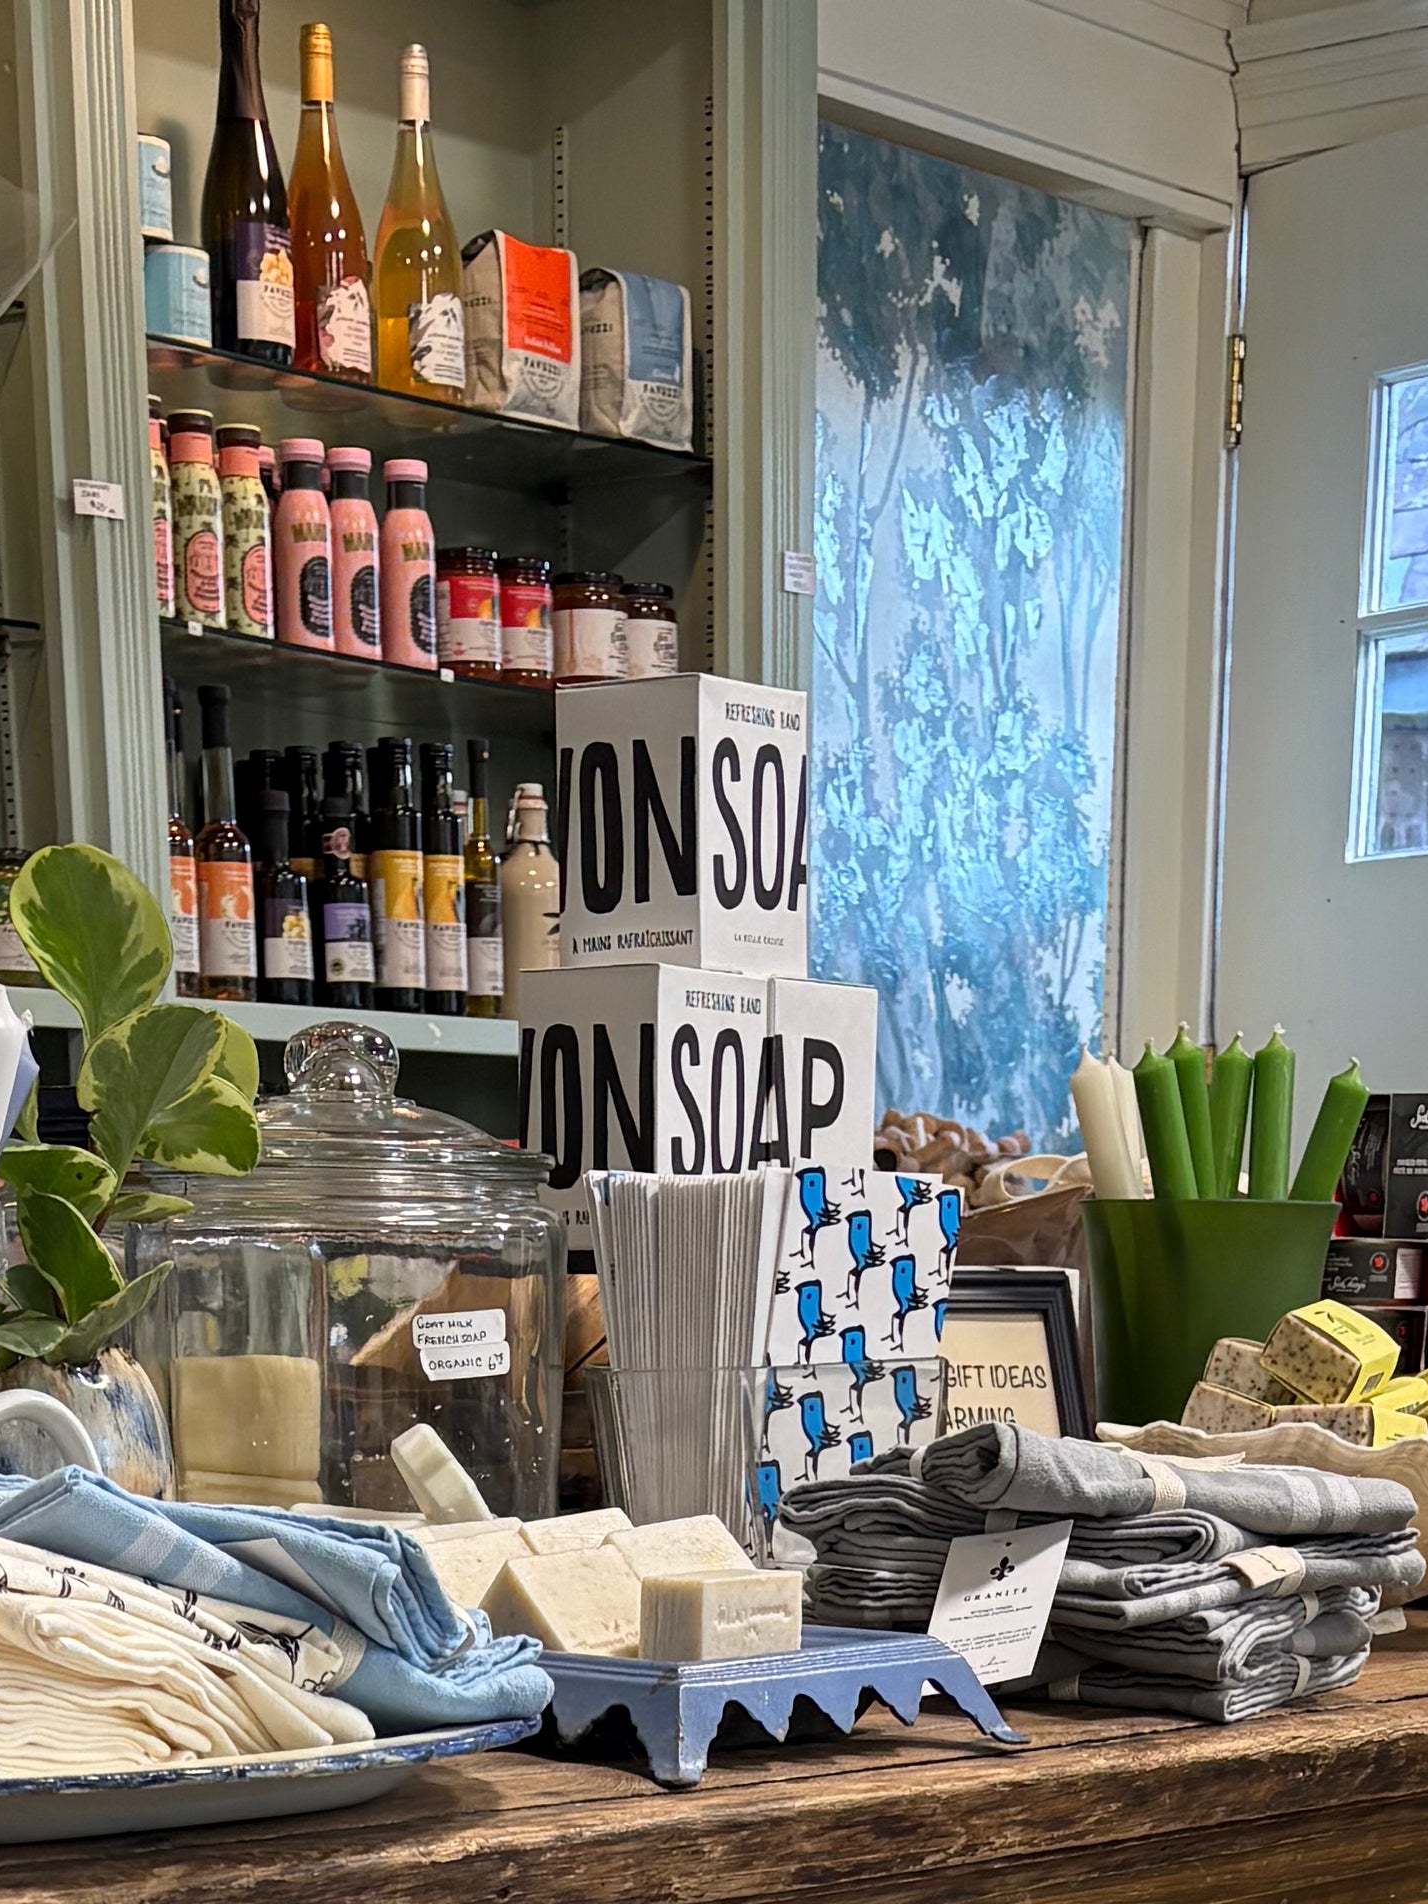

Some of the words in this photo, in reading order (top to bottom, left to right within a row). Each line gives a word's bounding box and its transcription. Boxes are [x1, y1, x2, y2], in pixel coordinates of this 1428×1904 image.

[724, 701, 776, 729] REFRESHING
[582, 934, 613, 954] MAINS
[684, 989, 736, 1014] REFRESHING
[670, 1023, 845, 1176] SOAP
[417, 1333, 459, 1345] FRENCH
[461, 1330, 487, 1343] SOAP
[428, 1357, 483, 1371] ORGANIC
[946, 1364, 986, 1389] GIFT
[989, 1364, 1048, 1390] IDEAS
[963, 1586, 1028, 1602] GRANITE
